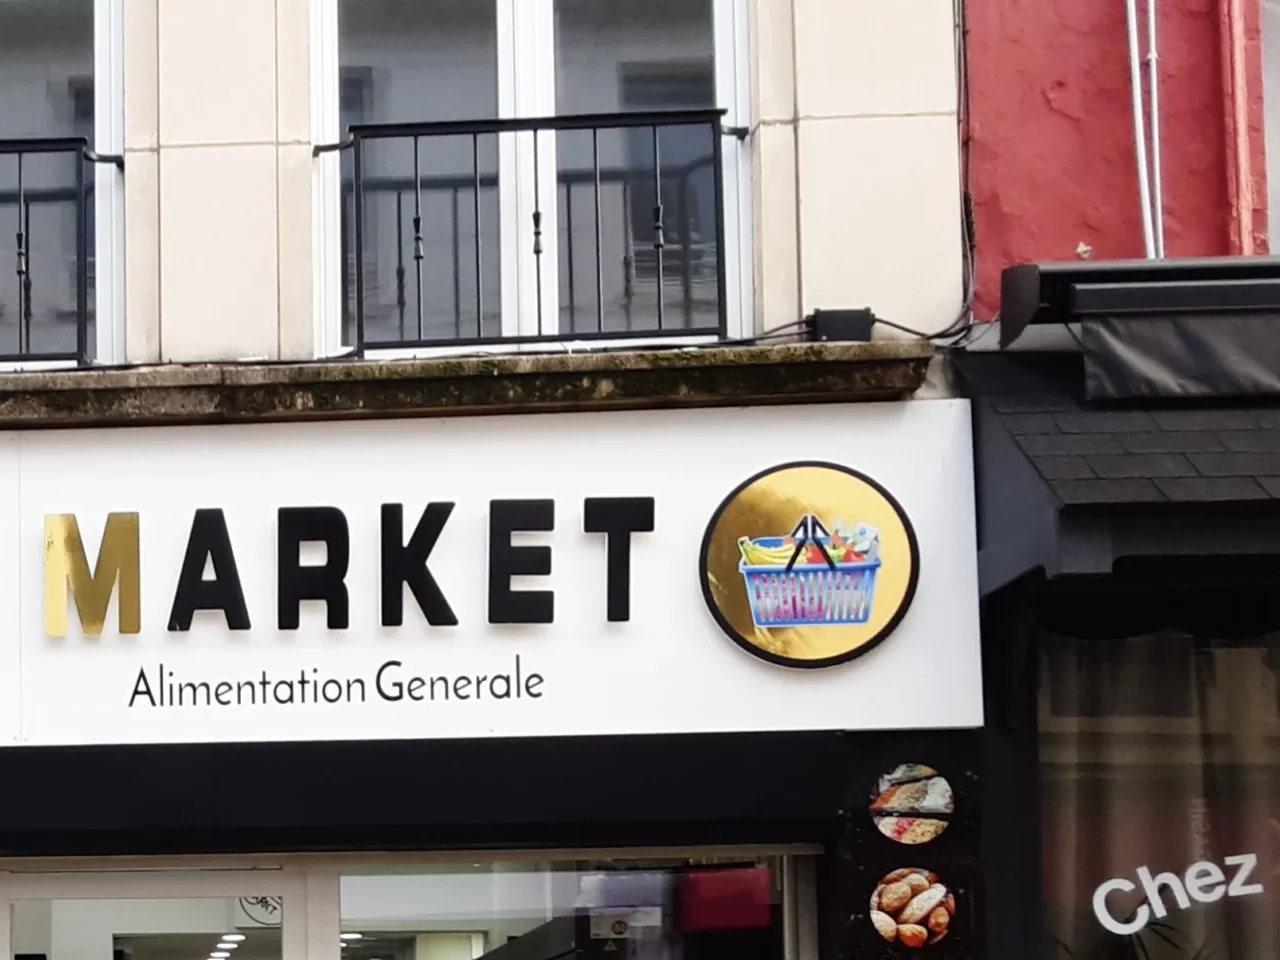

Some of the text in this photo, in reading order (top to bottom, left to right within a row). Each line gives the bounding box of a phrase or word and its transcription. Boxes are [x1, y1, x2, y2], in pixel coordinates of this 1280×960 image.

[44, 496, 655, 638] MARKET
[129, 654, 544, 708] Alimentation Generale
[1093, 853, 1264, 935] Chez
